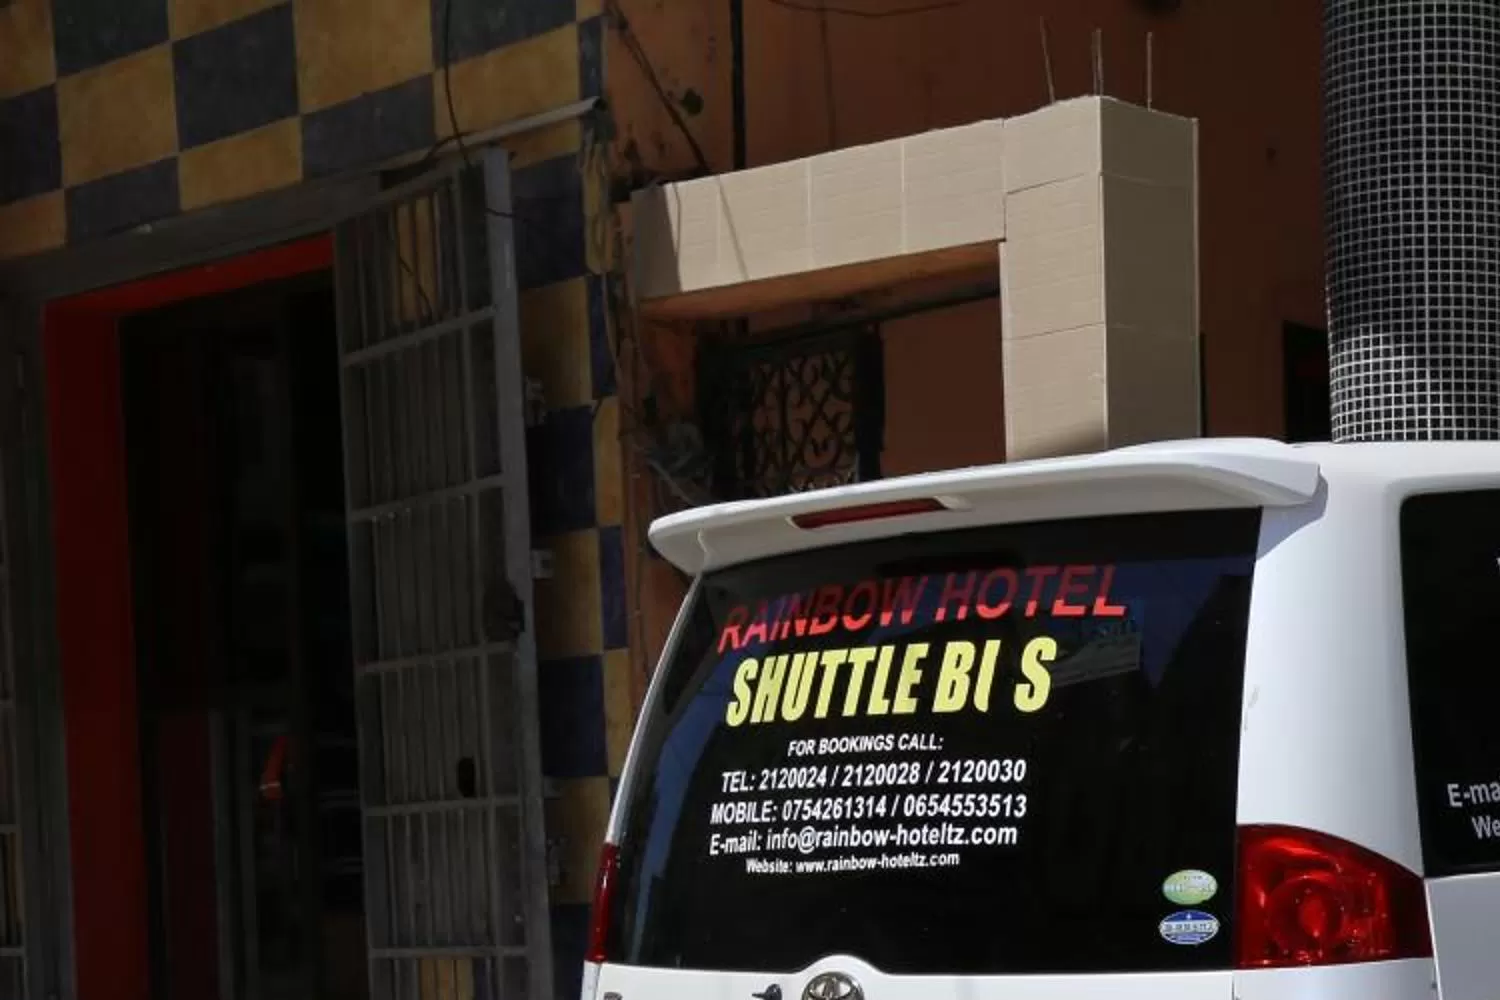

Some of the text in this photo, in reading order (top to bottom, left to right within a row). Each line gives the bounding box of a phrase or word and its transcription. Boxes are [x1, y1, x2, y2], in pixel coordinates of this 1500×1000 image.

[717, 564, 1127, 654] RAINBOW HOTEL
[725, 642, 930, 728] SHUTTLE
[787, 731, 944, 757] FOR BOOKINGS CALL:
[721, 758, 1028, 793] TEL: 2120024 / 2120028 / 2120030
[710, 793, 1028, 824] MOBILE: 0754261314 / 0654553513
[709, 821, 1019, 856] E-mail: info@rainbow-hoteltz.com
[745, 851, 960, 875] Website: www.rainbow-hoteltz.com
